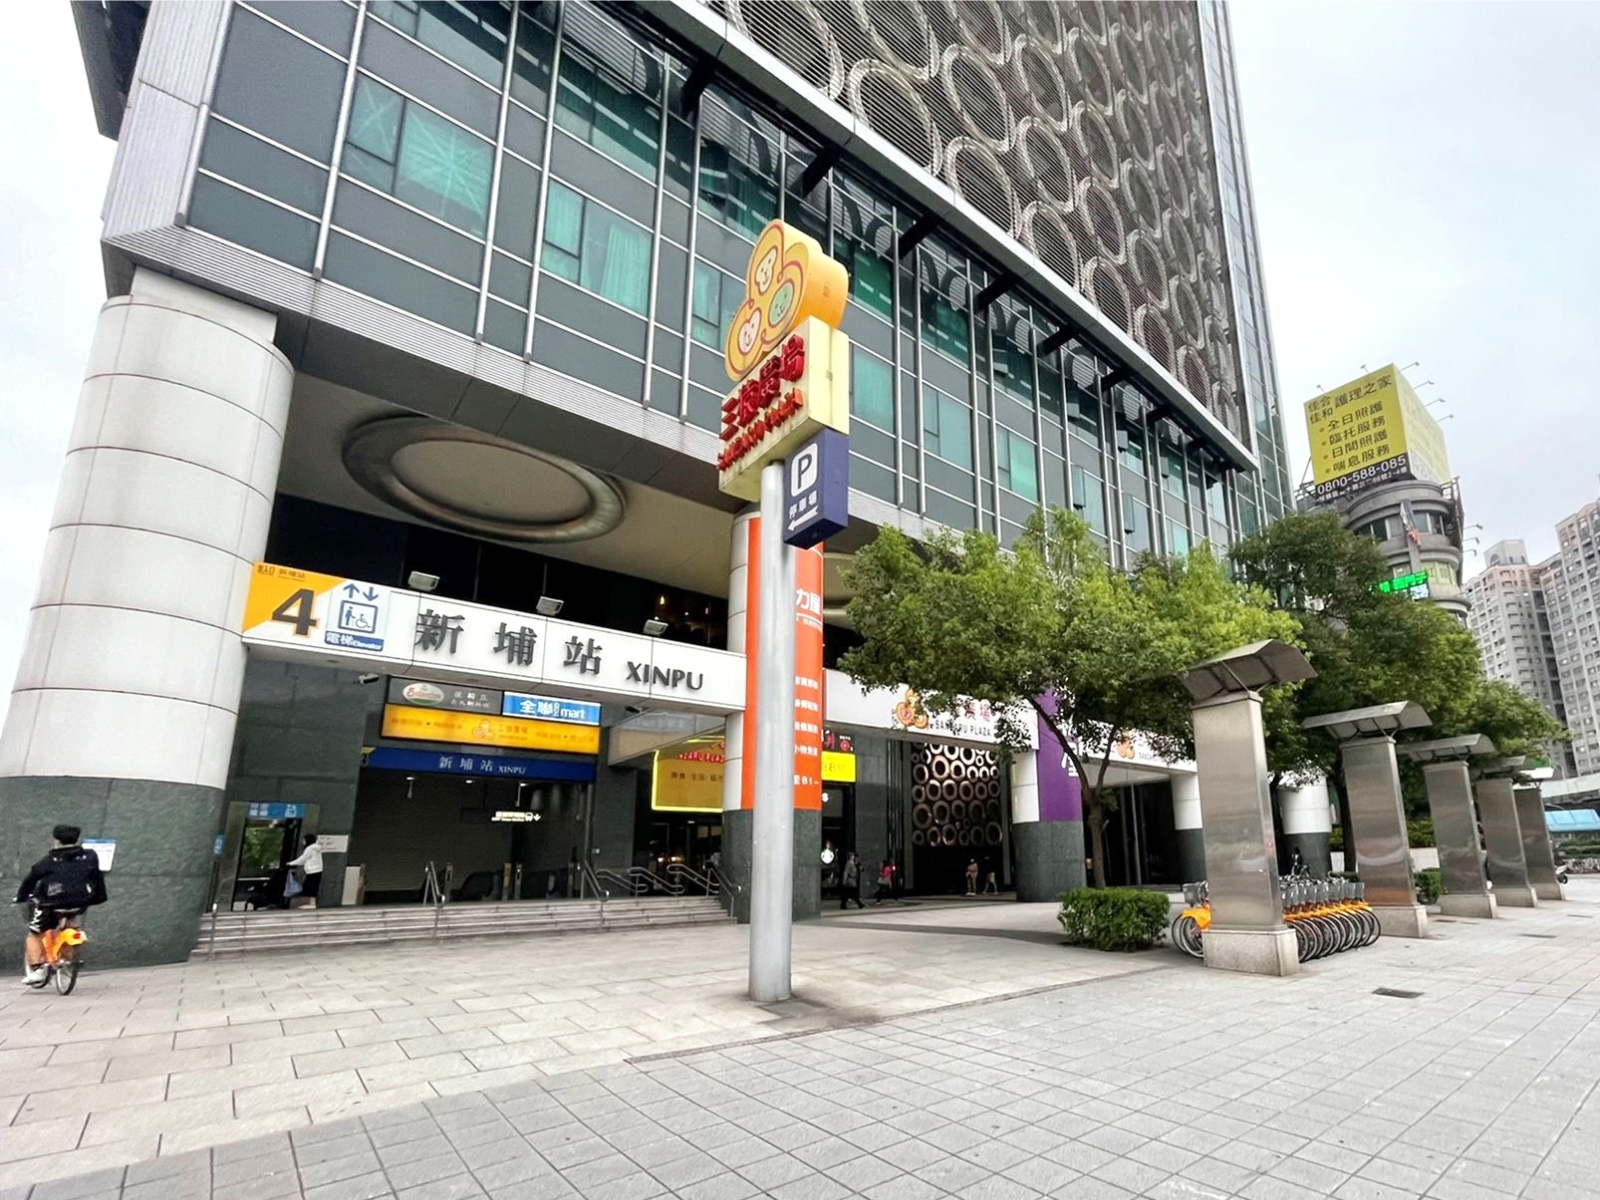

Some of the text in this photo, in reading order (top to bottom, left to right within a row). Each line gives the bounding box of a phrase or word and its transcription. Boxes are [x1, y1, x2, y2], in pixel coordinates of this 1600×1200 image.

[1334, 375, 1392, 408] 護理之家
[1328, 400, 1383, 432] 全日照護
[1329, 415, 1386, 445] 臨托服務
[1332, 429, 1387, 458] 日間照護
[1333, 444, 1390, 471] 喘息服務
[797, 453, 813, 490] P
[1317, 455, 1406, 495] 0800-588-085
[271, 588, 318, 636] 4
[414, 608, 704, 691] 新埔站 XINPU
[520, 699, 553, 716] 全聯
[560, 708, 586, 720] mart
[439, 756, 527, 775] 新埔站 XINPU
